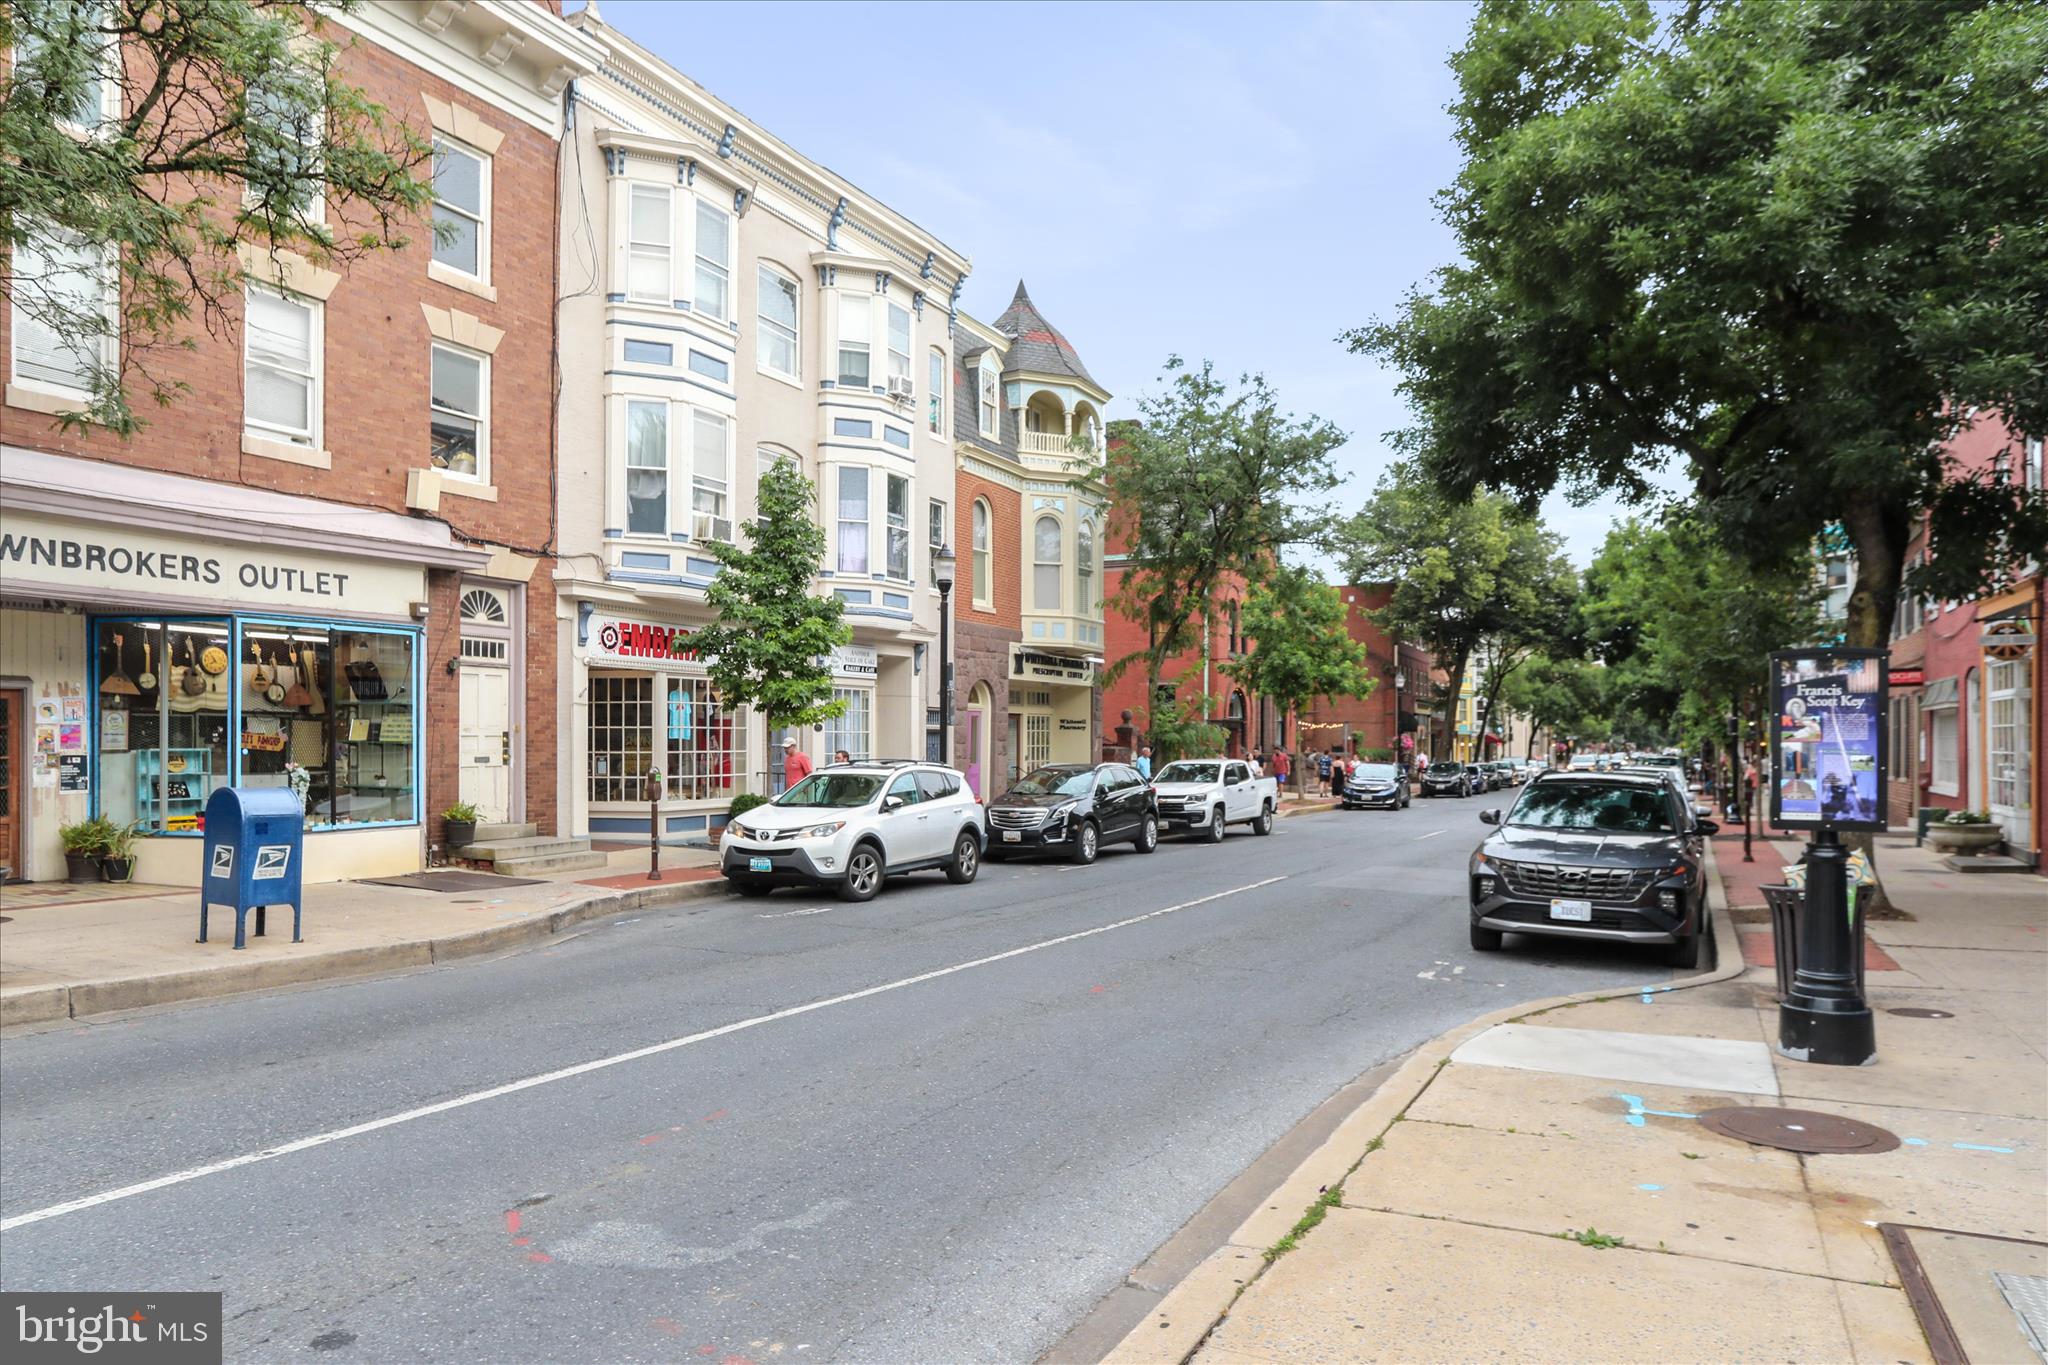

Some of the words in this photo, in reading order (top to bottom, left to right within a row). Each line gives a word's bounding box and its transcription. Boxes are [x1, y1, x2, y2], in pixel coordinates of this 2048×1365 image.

[238, 563, 349, 597] OUTLET
[1067, 671, 1083, 679] CENTER
[1797, 684, 1842, 696] Francis
[1806, 695, 1838, 707] Scott
[1840, 695, 1866, 709] Key
